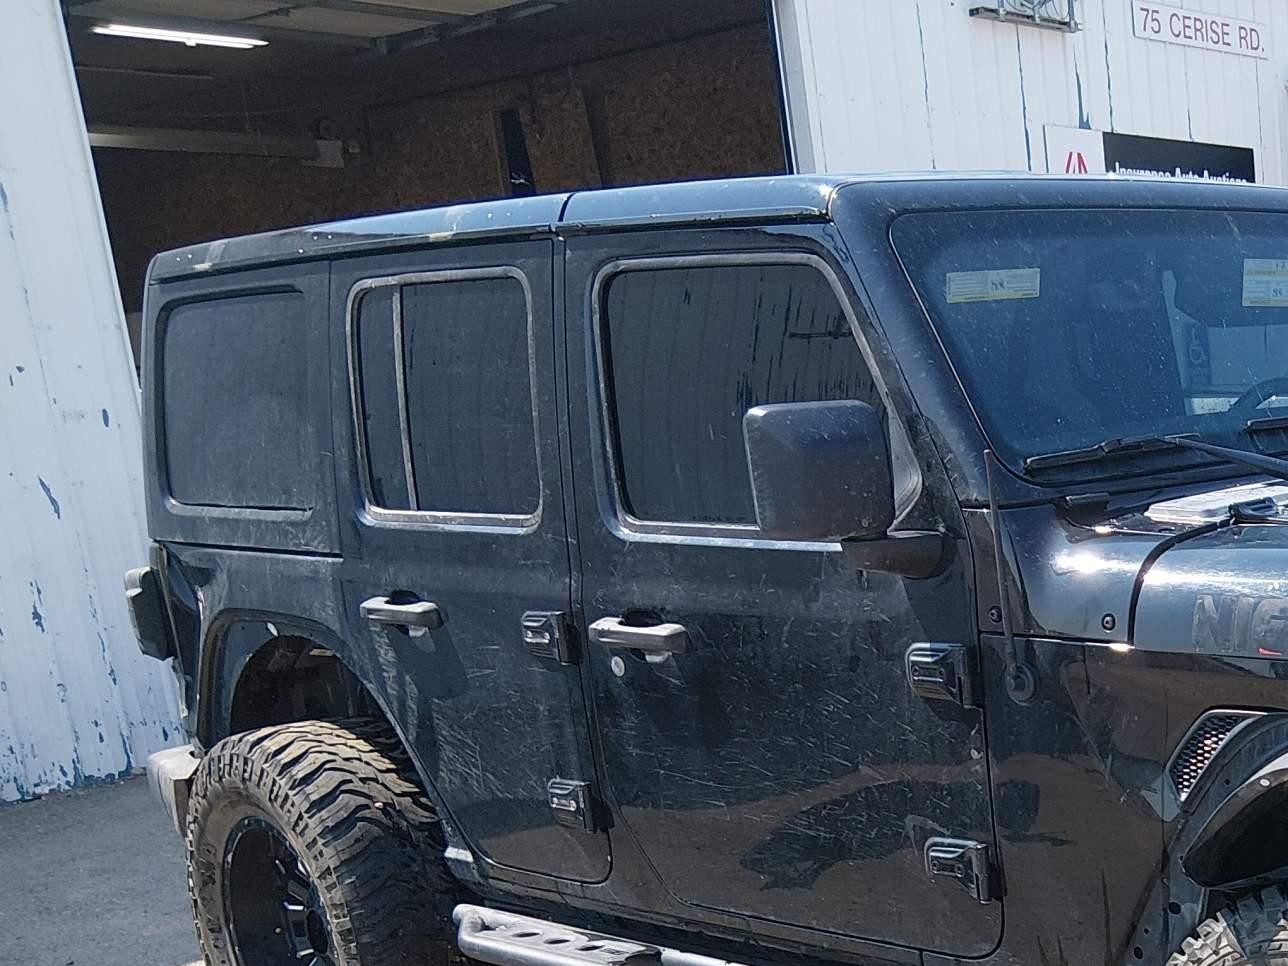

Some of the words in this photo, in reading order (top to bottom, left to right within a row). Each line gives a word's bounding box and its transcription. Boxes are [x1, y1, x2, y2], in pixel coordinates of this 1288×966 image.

[1140, 7, 1162, 34] 75
[1169, 12, 1232, 47] CERISE
[1238, 26, 1265, 53] RD.
